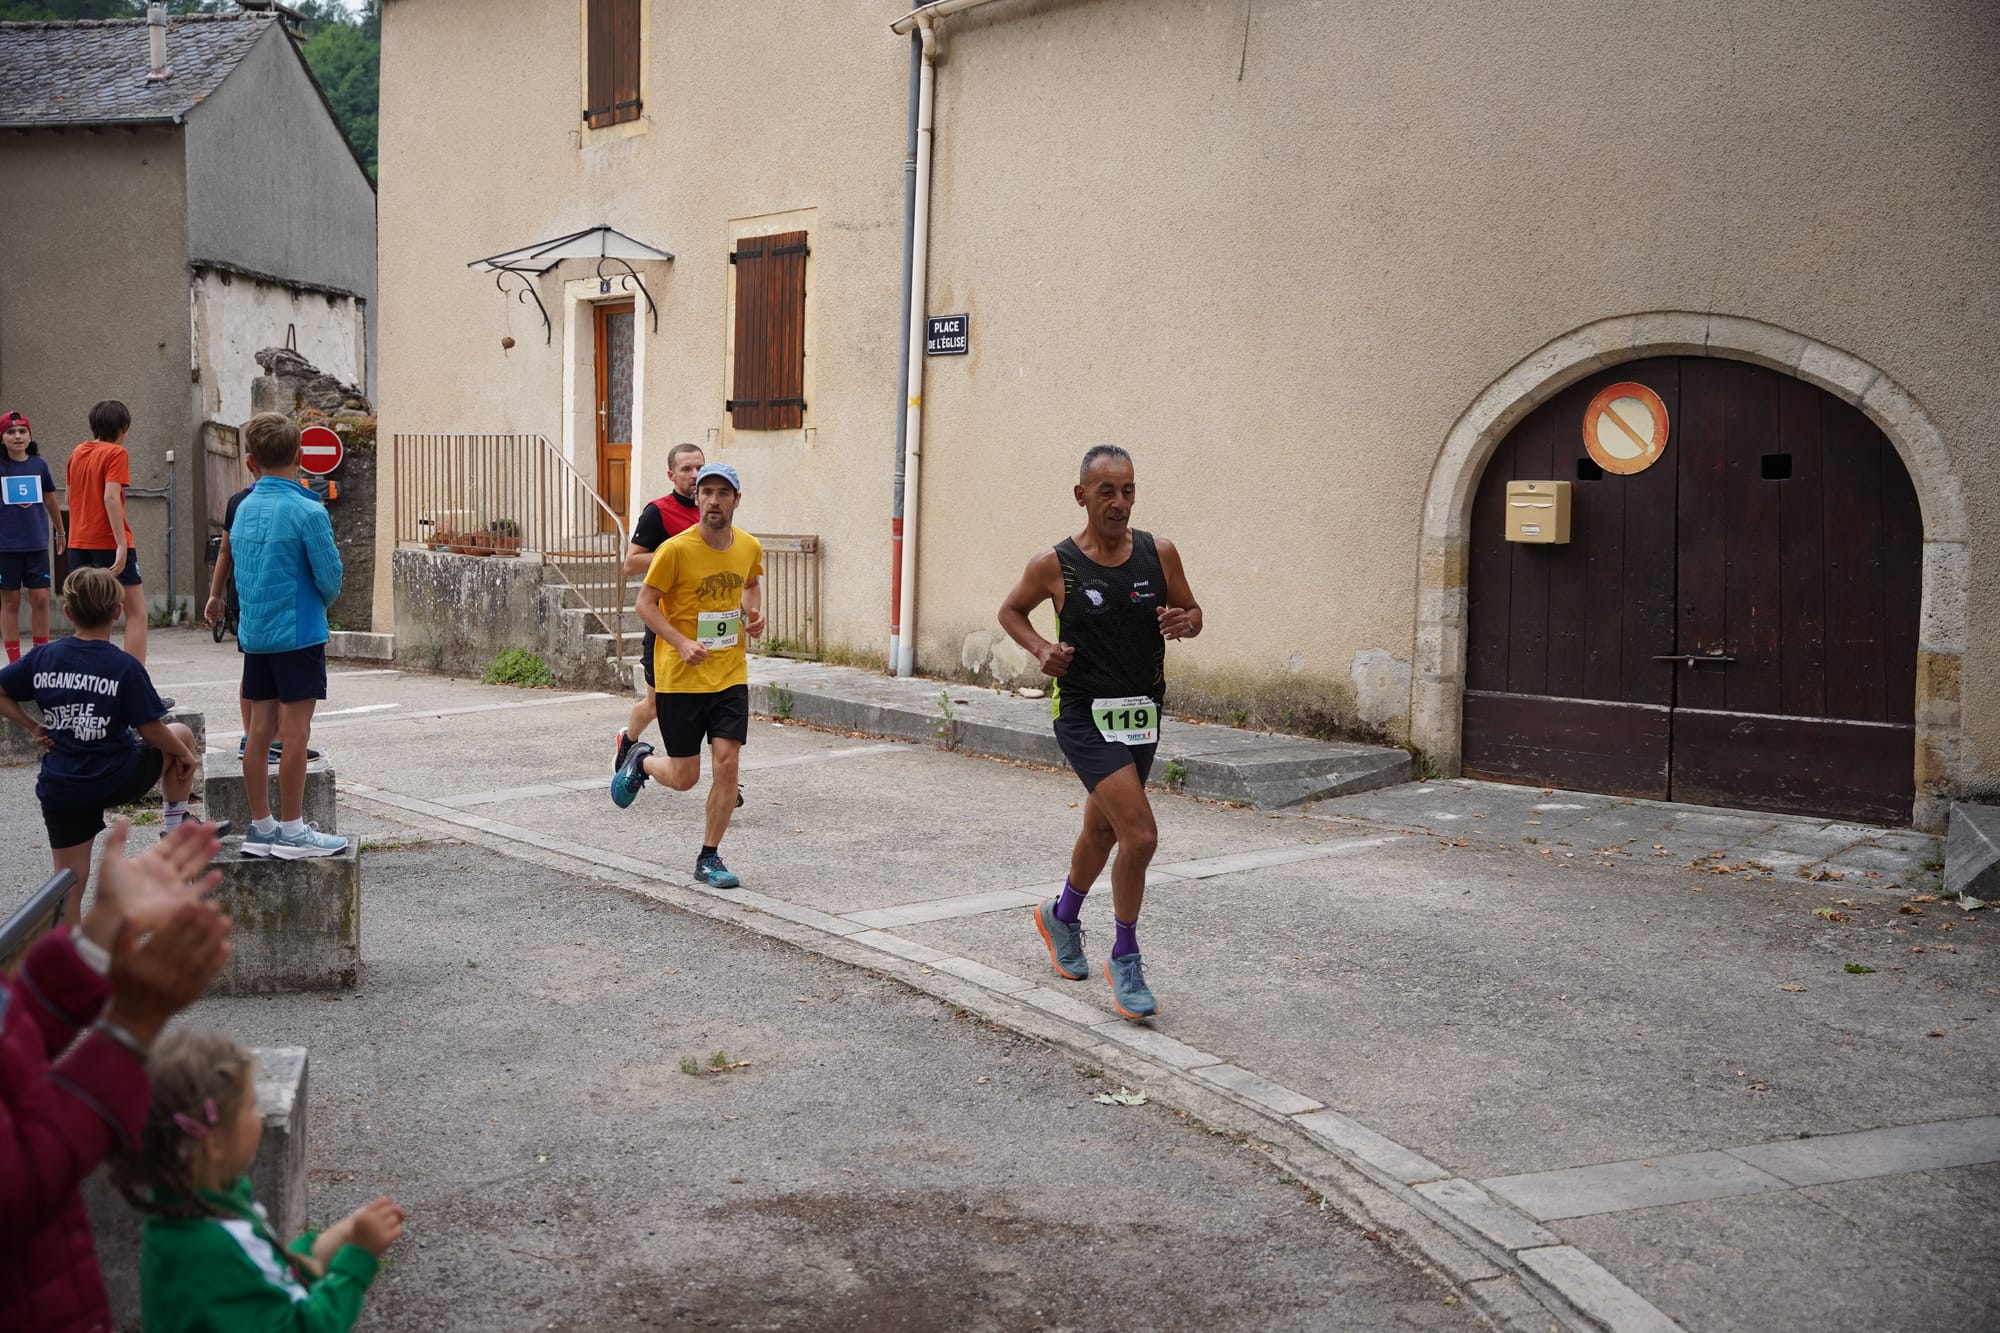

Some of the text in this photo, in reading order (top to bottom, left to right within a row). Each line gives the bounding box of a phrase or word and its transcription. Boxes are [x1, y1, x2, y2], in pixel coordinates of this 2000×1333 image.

[934, 321, 960, 333] PLACE
[928, 336, 965, 350] DE L'ÉGLISE
[18, 483, 28, 496] 5
[717, 622, 727, 637] 9
[33, 672, 119, 697] ORGANISATION
[1102, 709, 1149, 730] 119
